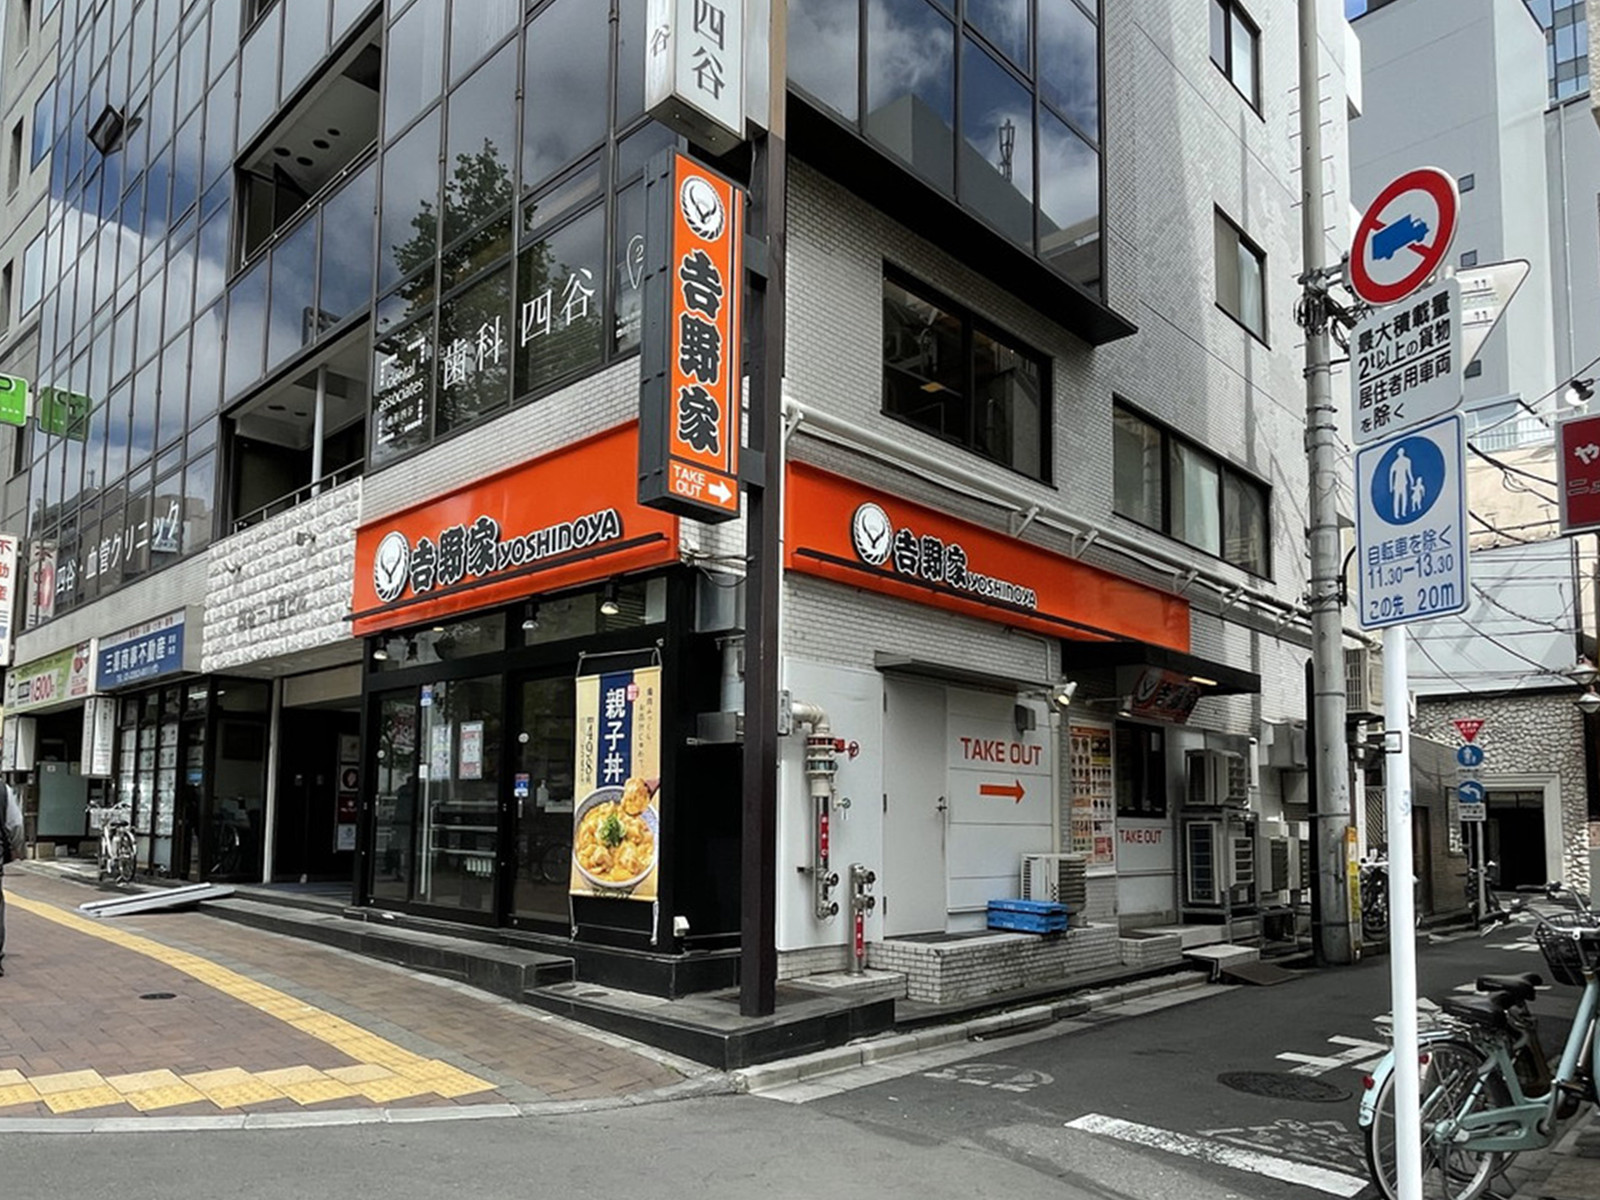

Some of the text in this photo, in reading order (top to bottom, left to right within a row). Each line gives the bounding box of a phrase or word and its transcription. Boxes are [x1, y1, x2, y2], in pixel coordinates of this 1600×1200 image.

[692, 0, 725, 101] 四谷
[1358, 290, 1450, 354] 最大積載量
[677, 248, 724, 457] 吉野家
[1360, 349, 1452, 410] 居住者用車両
[1361, 402, 1404, 433] を除く
[673, 465, 706, 486] TAKE
[675, 479, 704, 498] OUT
[410, 514, 500, 594] 吉野家
[893, 527, 969, 590] 吉野家
[1368, 524, 1453, 566] 自転車を除く
[1369, 582, 1455, 620] この先 20m
[603, 687, 626, 783] 親子丼
[960, 737, 1042, 766] TAKE OUT
[1119, 829, 1162, 844] TAKE OUT
